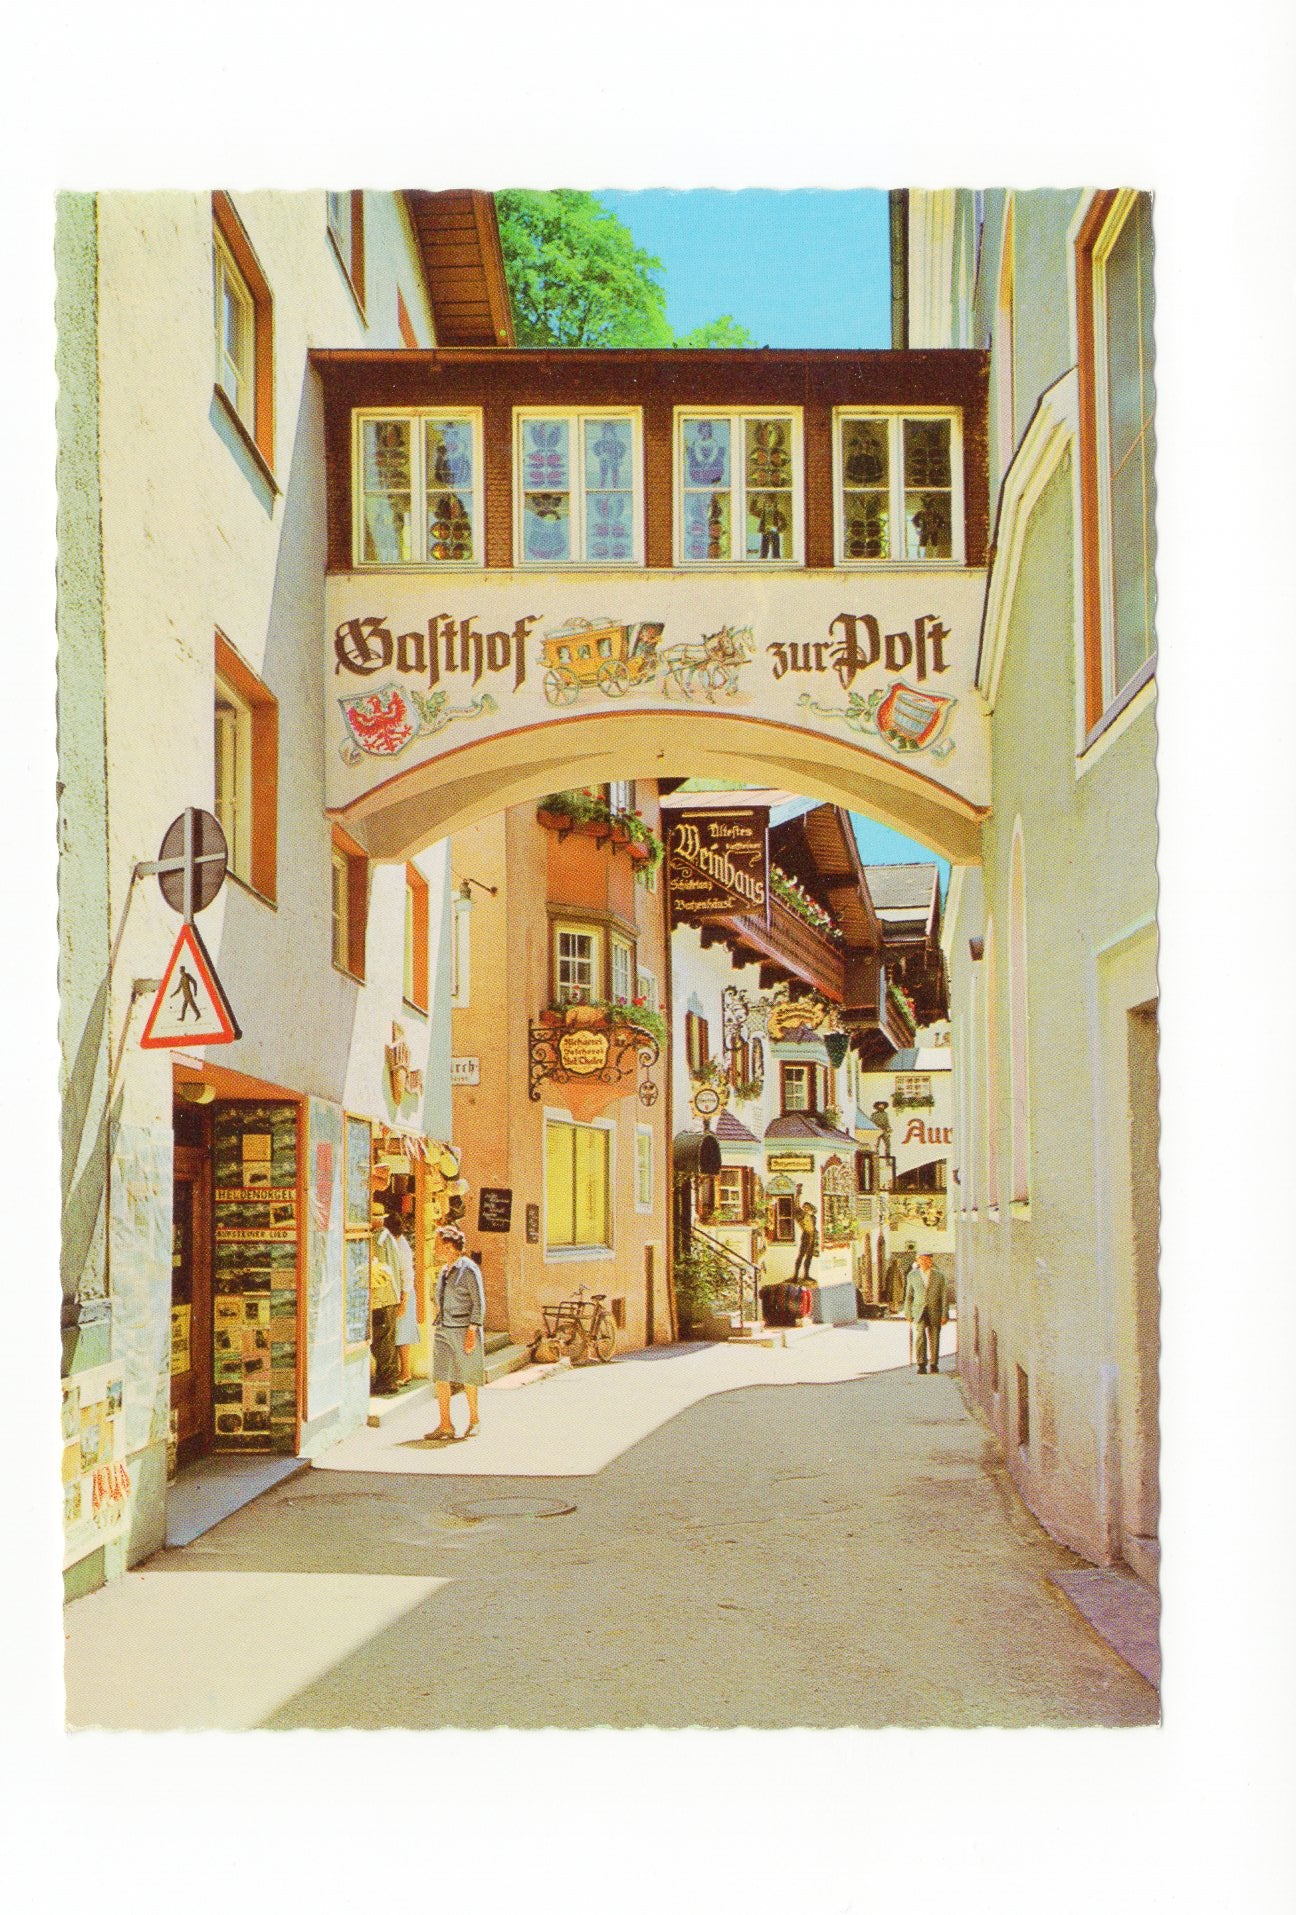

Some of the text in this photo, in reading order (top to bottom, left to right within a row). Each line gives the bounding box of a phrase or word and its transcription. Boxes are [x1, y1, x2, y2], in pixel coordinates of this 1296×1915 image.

[334, 612, 544, 694] Gasthof
[768, 612, 951, 690] zur Post
[674, 823, 765, 904] Weinhaus
